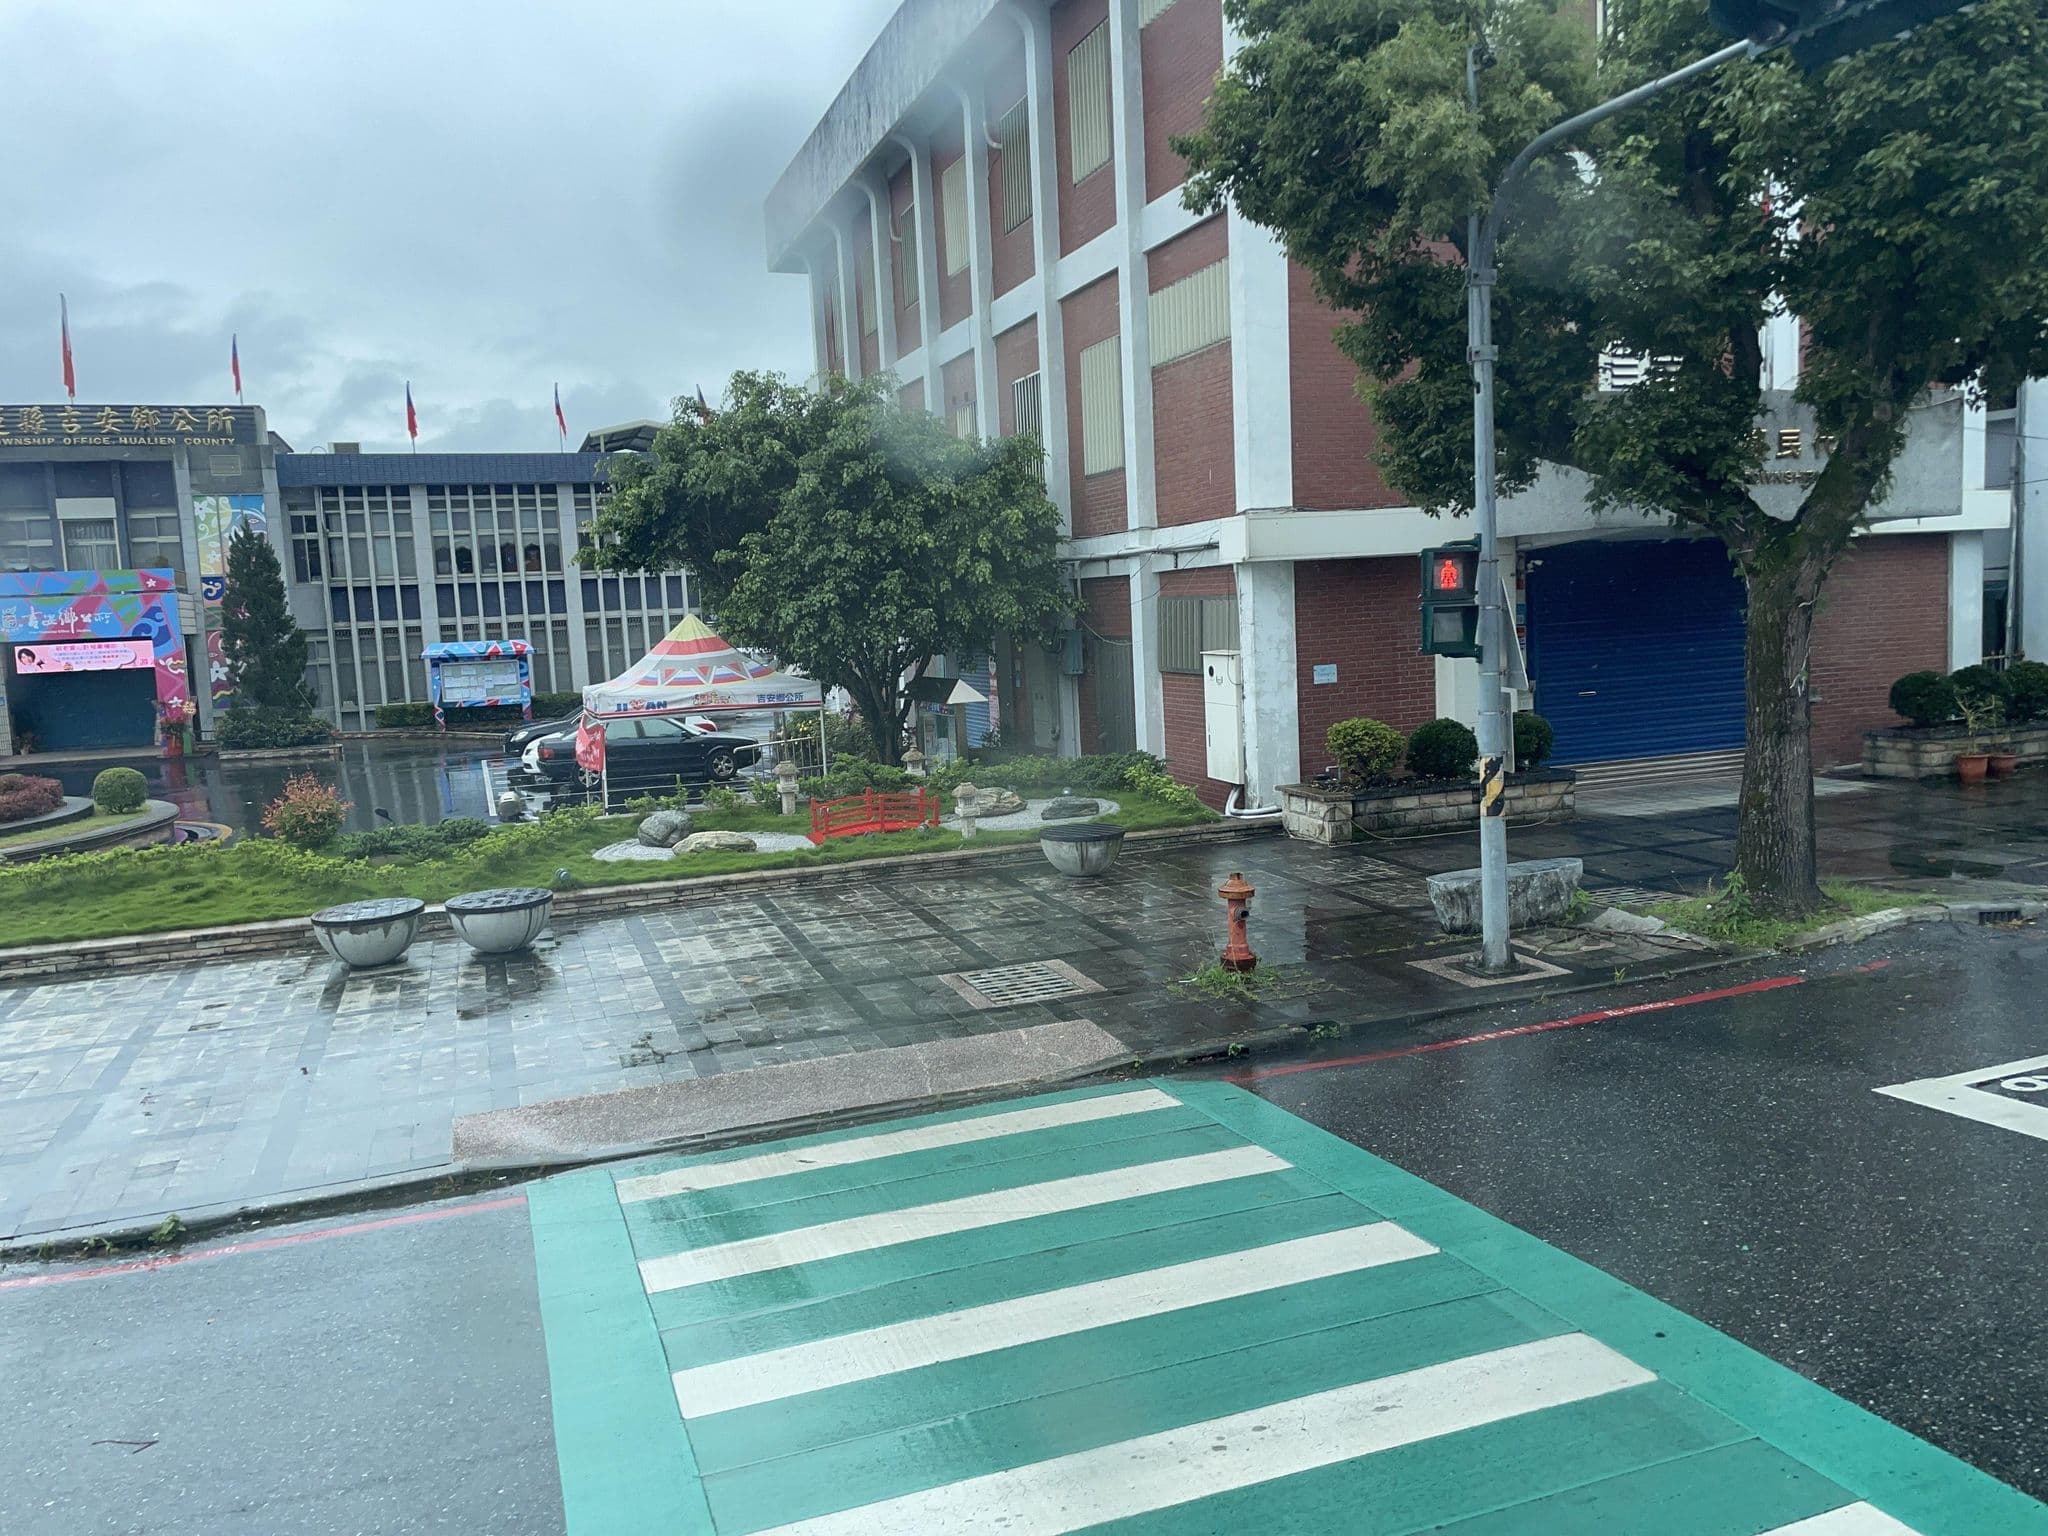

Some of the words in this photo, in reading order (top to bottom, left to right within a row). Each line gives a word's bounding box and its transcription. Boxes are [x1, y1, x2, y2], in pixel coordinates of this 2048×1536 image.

[0, 437, 55, 446] WNSHIP
[119, 437, 176, 446] HUALIEN
[184, 437, 235, 446] COUNTY
[756, 692, 804, 704] 吉安鄉公所
